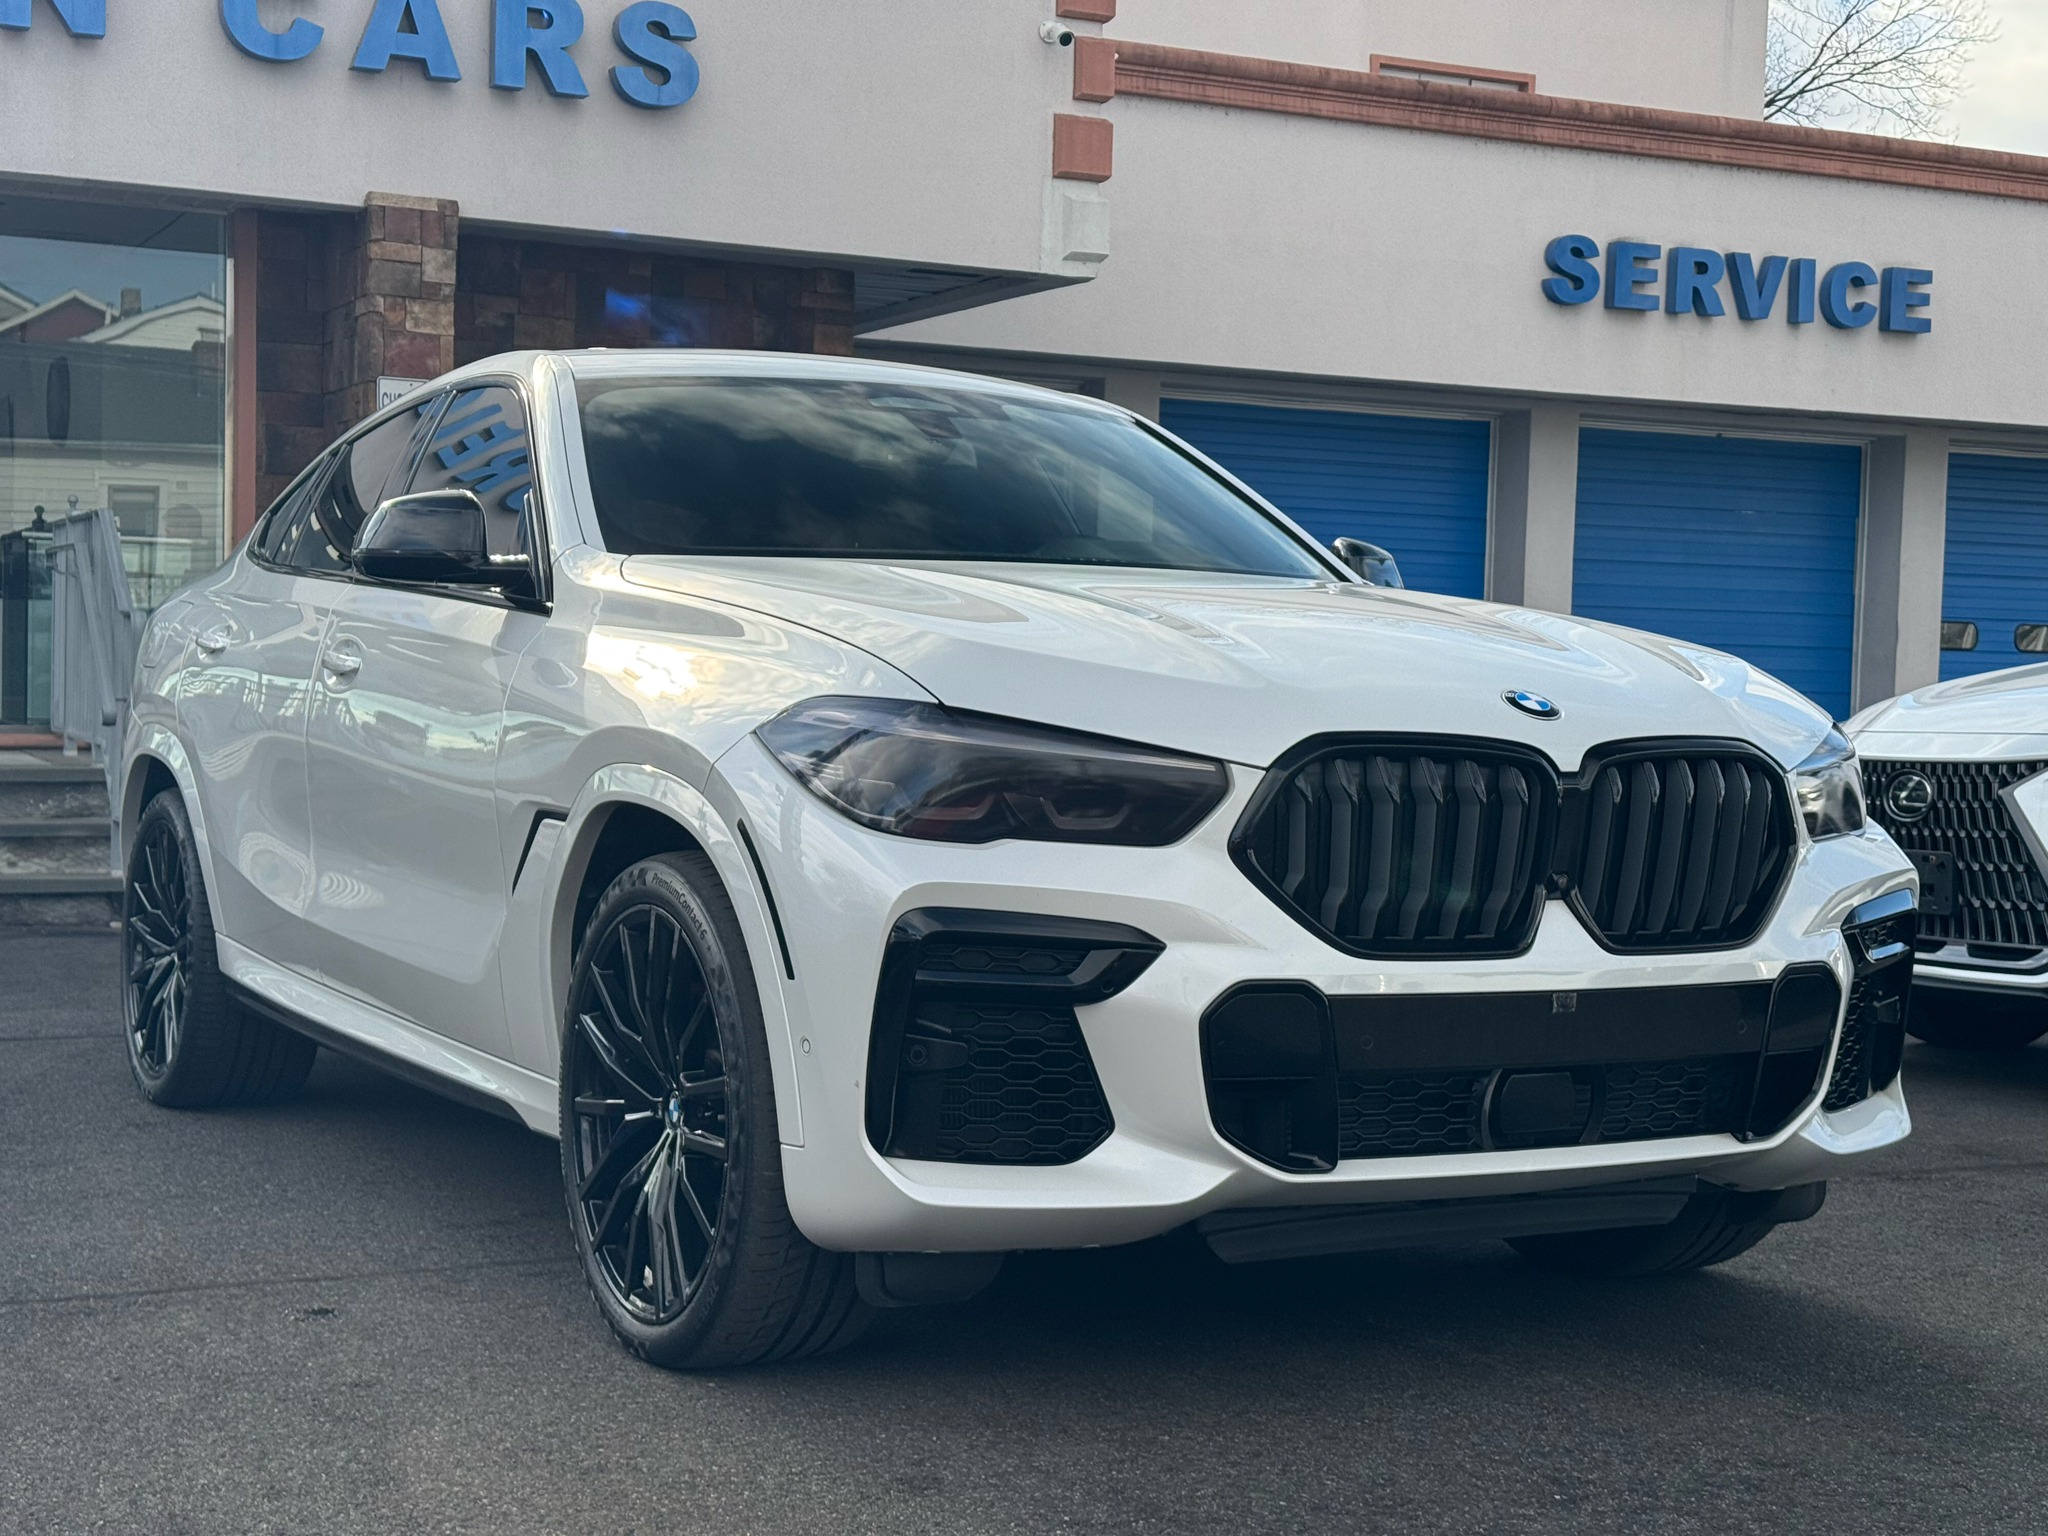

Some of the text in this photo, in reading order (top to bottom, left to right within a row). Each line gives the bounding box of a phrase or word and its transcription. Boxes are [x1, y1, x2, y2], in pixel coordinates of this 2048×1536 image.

[218, 0, 700, 109] CARS
[1541, 234, 1934, 334] SERVICE
[651, 872, 708, 940] PremiumContact 6
